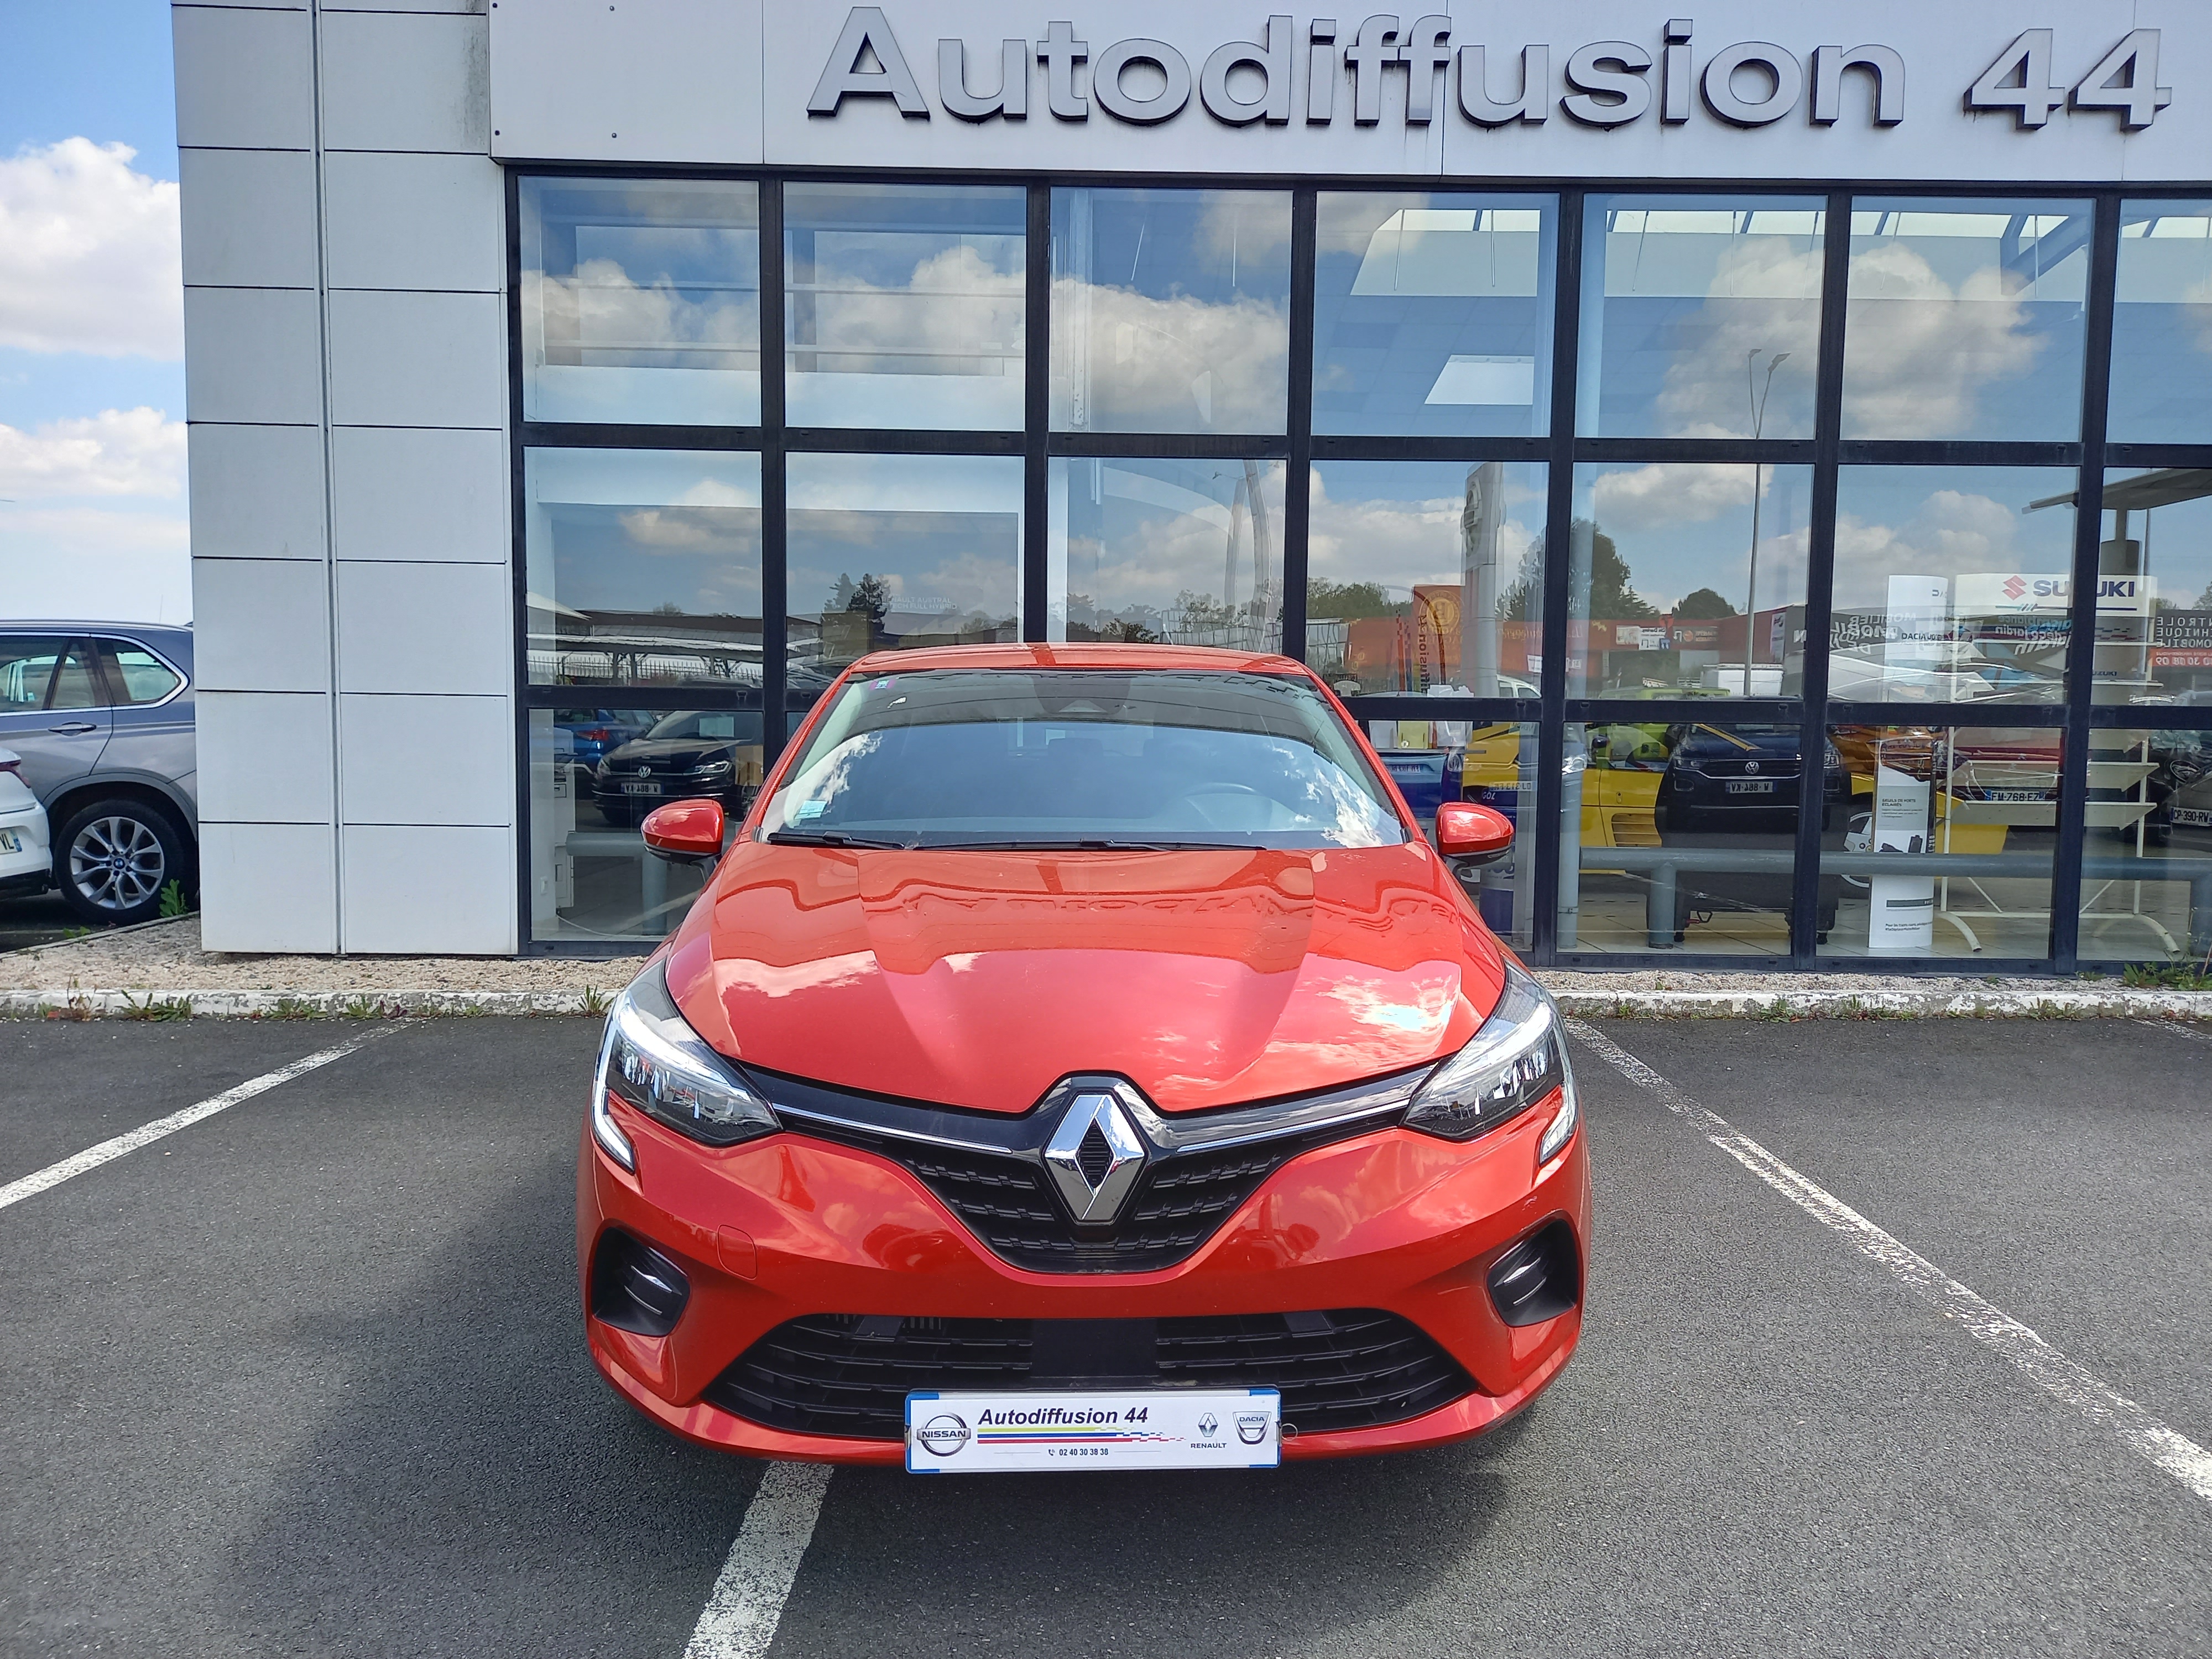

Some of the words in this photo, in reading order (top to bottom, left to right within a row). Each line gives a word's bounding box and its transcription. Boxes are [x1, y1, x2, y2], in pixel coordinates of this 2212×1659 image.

[806, 6, 1906, 126] Autodiffusion
[1962, 28, 2172, 131] 44
[2033, 580, 2135, 597] SUUKI
[977, 1407, 1118, 1426] Autodiffusion
[1124, 1406, 1148, 1423] 44
